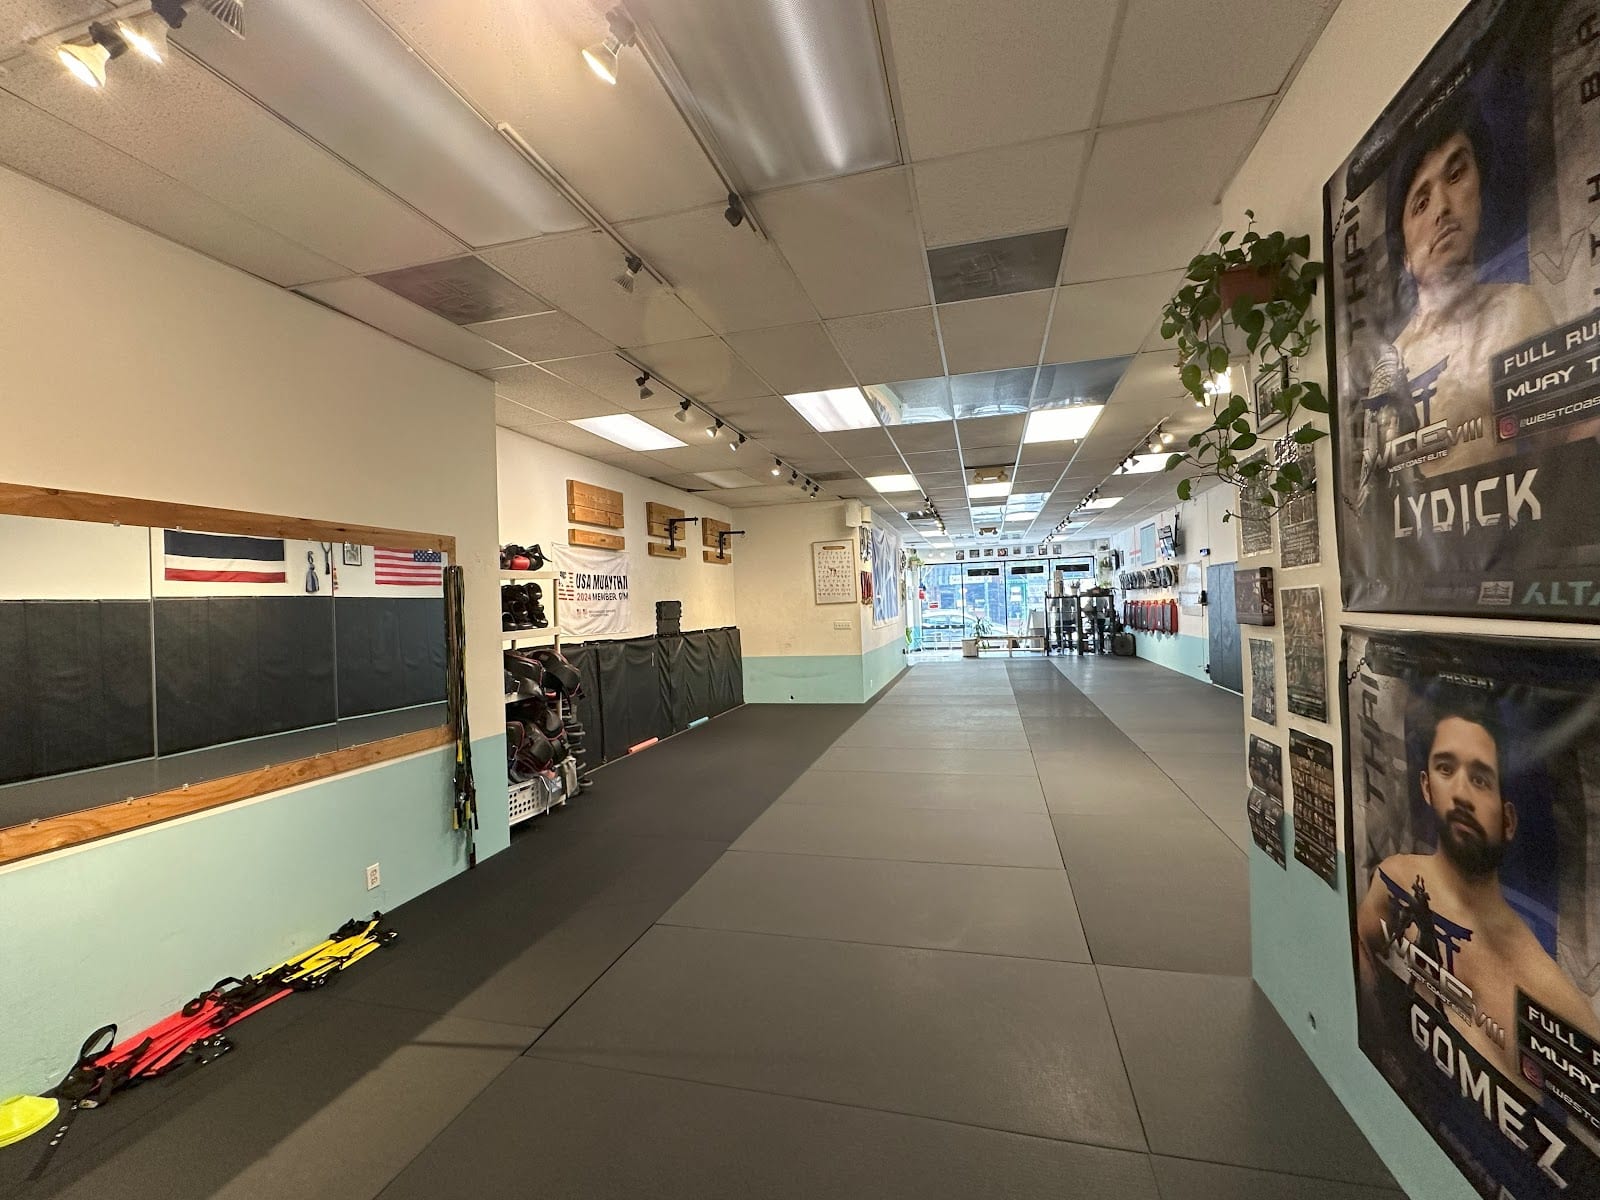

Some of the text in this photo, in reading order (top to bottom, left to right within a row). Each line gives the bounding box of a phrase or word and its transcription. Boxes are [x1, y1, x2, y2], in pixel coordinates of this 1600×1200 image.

[1503, 319, 1600, 375] FULL RU
[1506, 365, 1575, 402] MUAY
[1387, 449, 1448, 474] WEST COAST ELITE
[1394, 468, 1542, 541] LYDICK
[576, 573, 591, 589] USA
[576, 592, 591, 601] 2024
[592, 592, 617, 601] MEMBER
[1528, 1005, 1583, 1054] FULL
[1530, 1036, 1600, 1095] MUAY
[1410, 1003, 1568, 1189] GOMEZ
